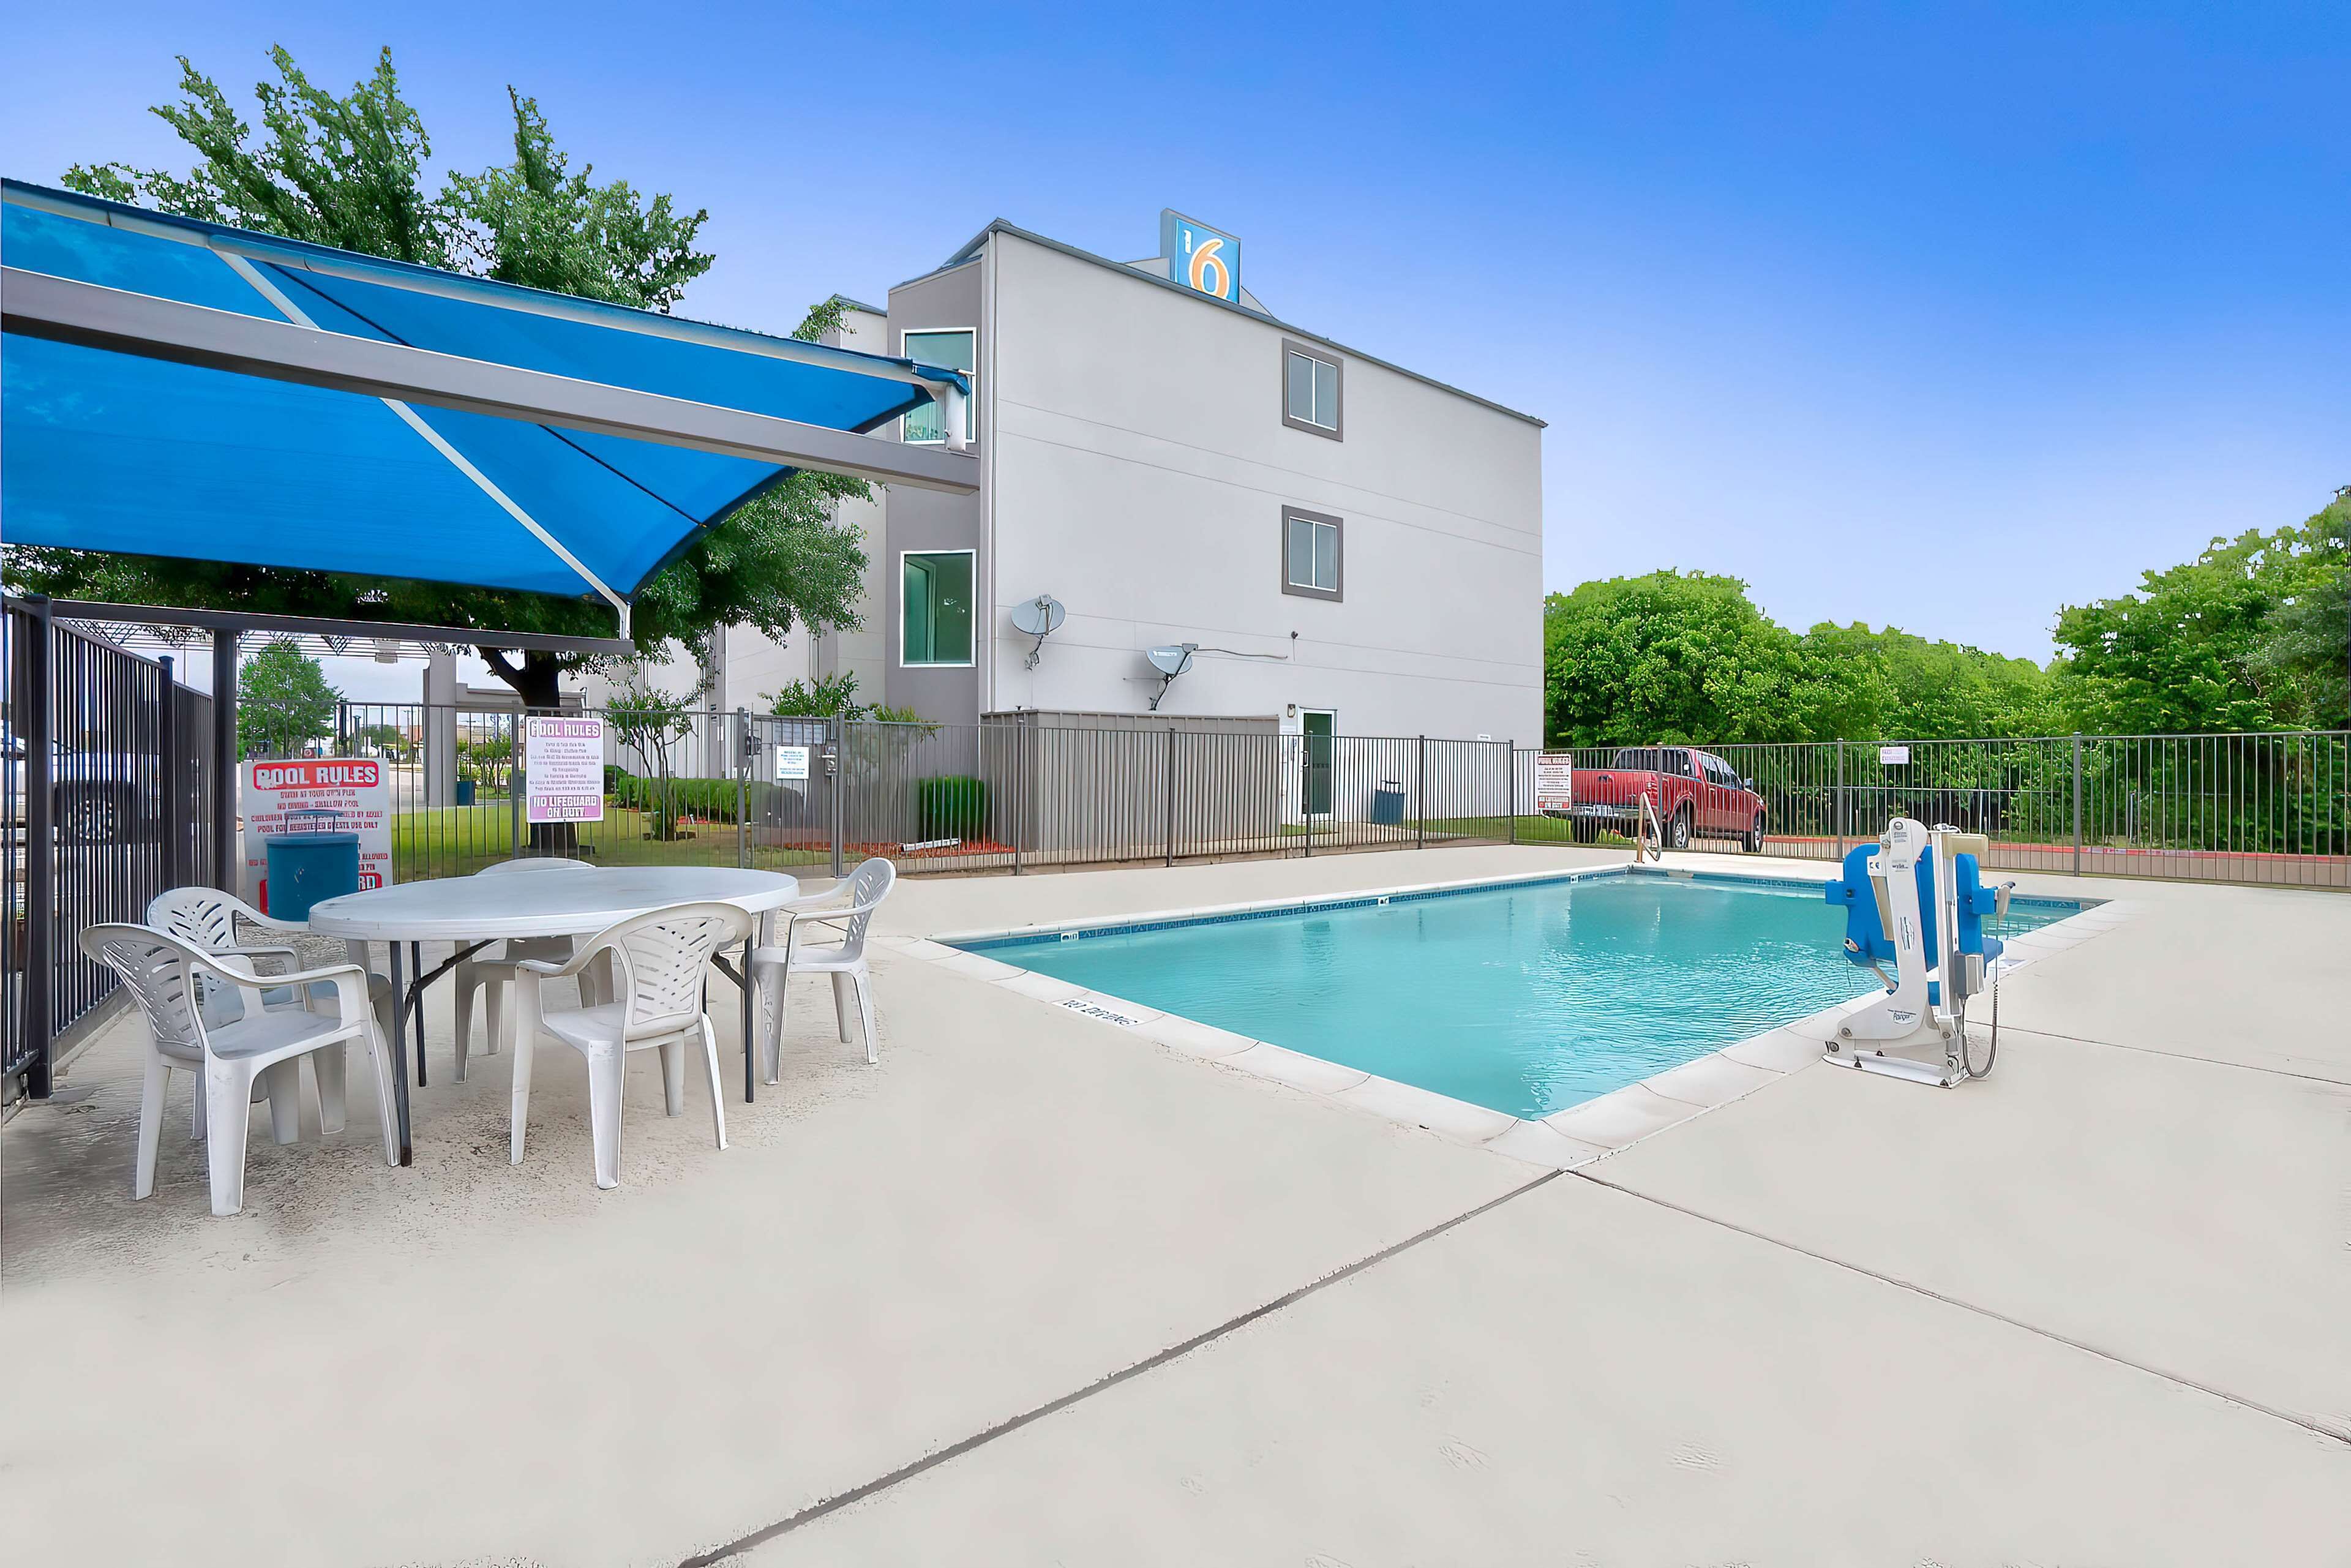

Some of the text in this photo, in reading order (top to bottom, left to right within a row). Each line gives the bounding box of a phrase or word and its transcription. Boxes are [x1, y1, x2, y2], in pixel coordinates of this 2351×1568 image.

[564, 722, 599, 737] RULES
[256, 766, 376, 785] POOL RULES
[549, 796, 598, 808] LIFEGUARD
